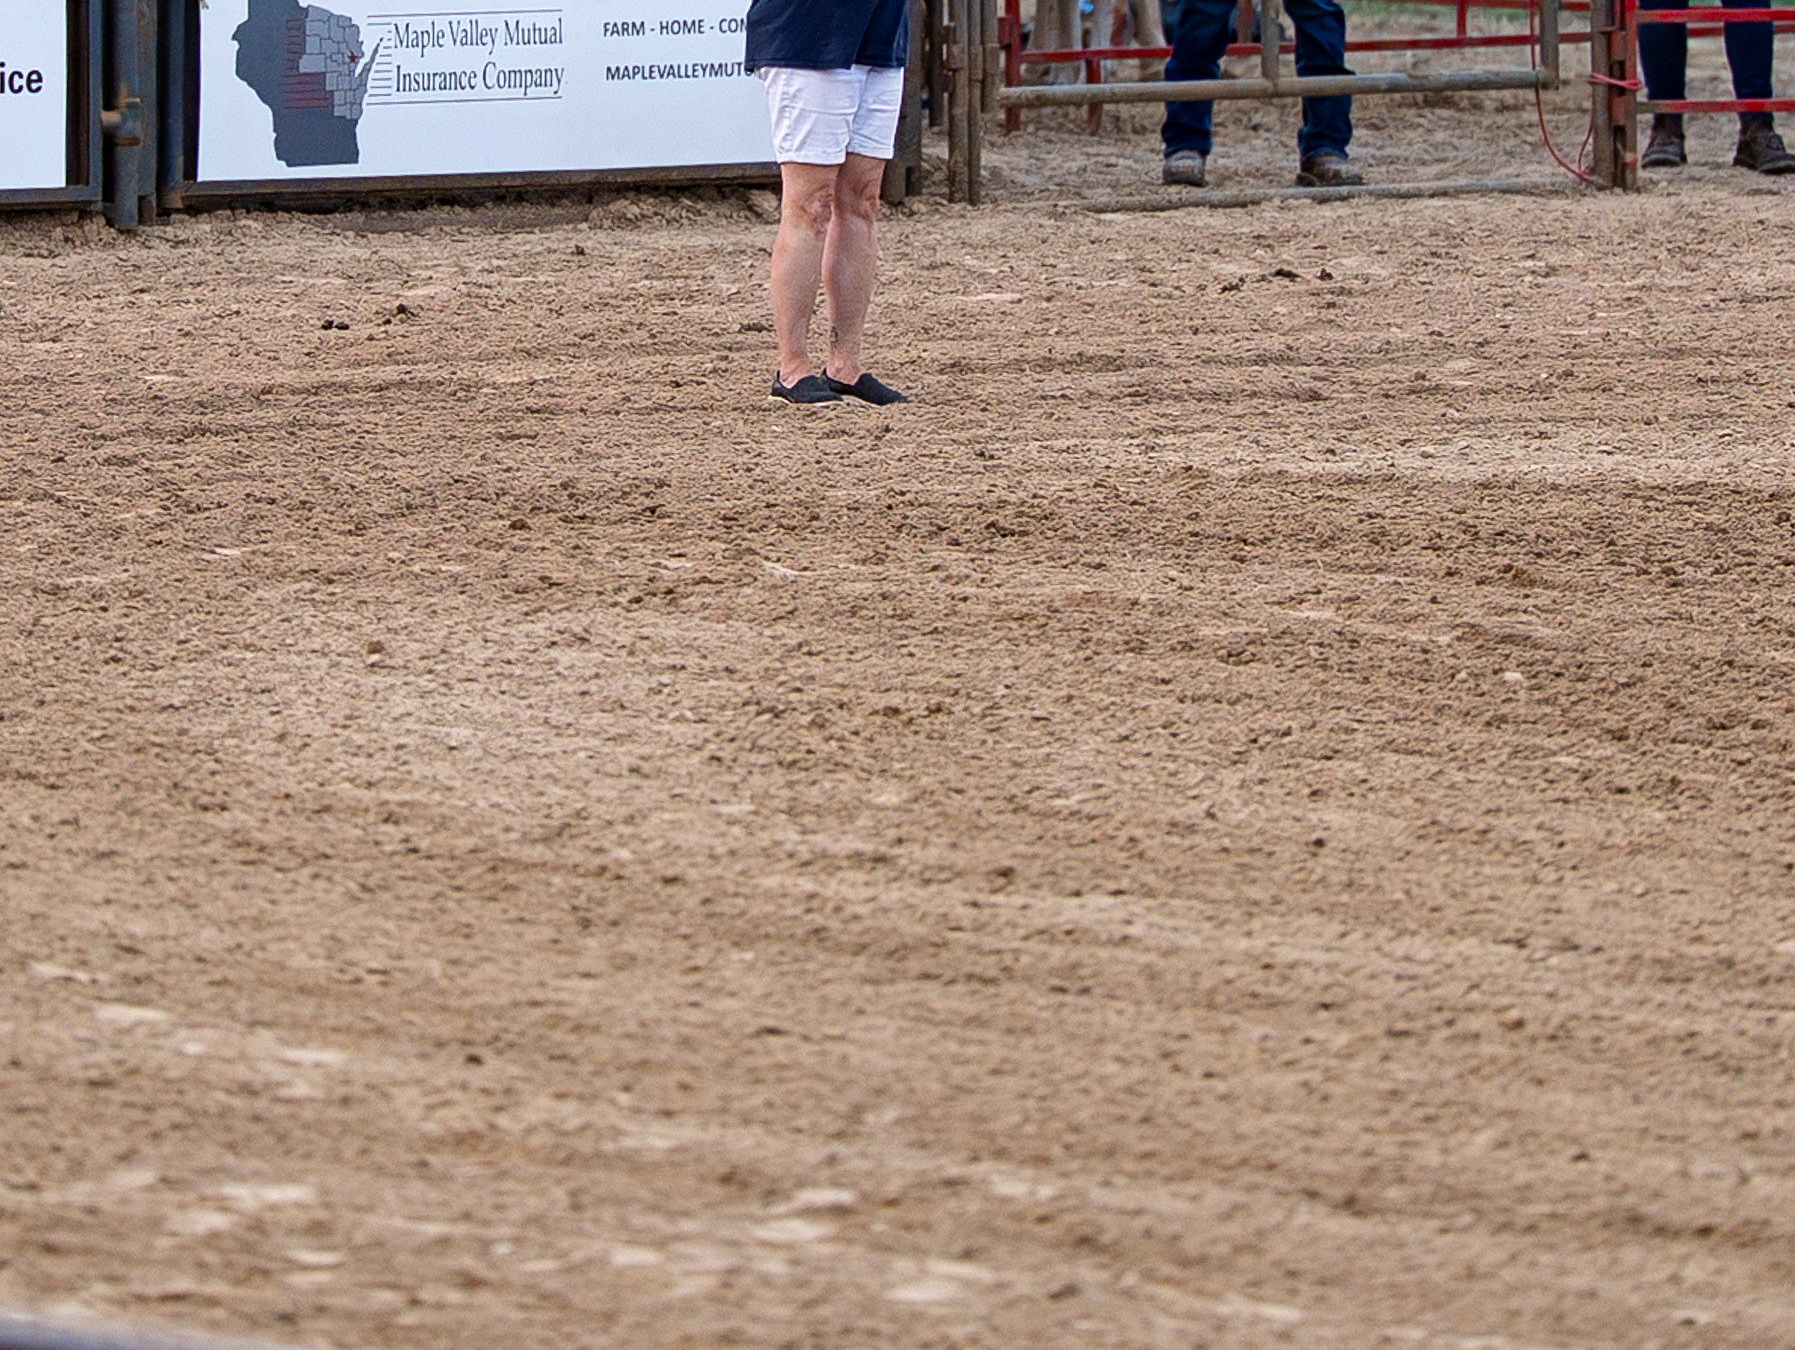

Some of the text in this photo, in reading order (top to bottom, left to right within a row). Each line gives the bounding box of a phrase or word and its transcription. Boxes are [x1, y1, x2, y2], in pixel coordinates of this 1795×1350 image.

[394, 17, 563, 58] Maple Valley Mutual
[603, 21, 646, 37] FARM
[659, 19, 705, 36] HOME
[396, 61, 565, 96] Insurance Company
